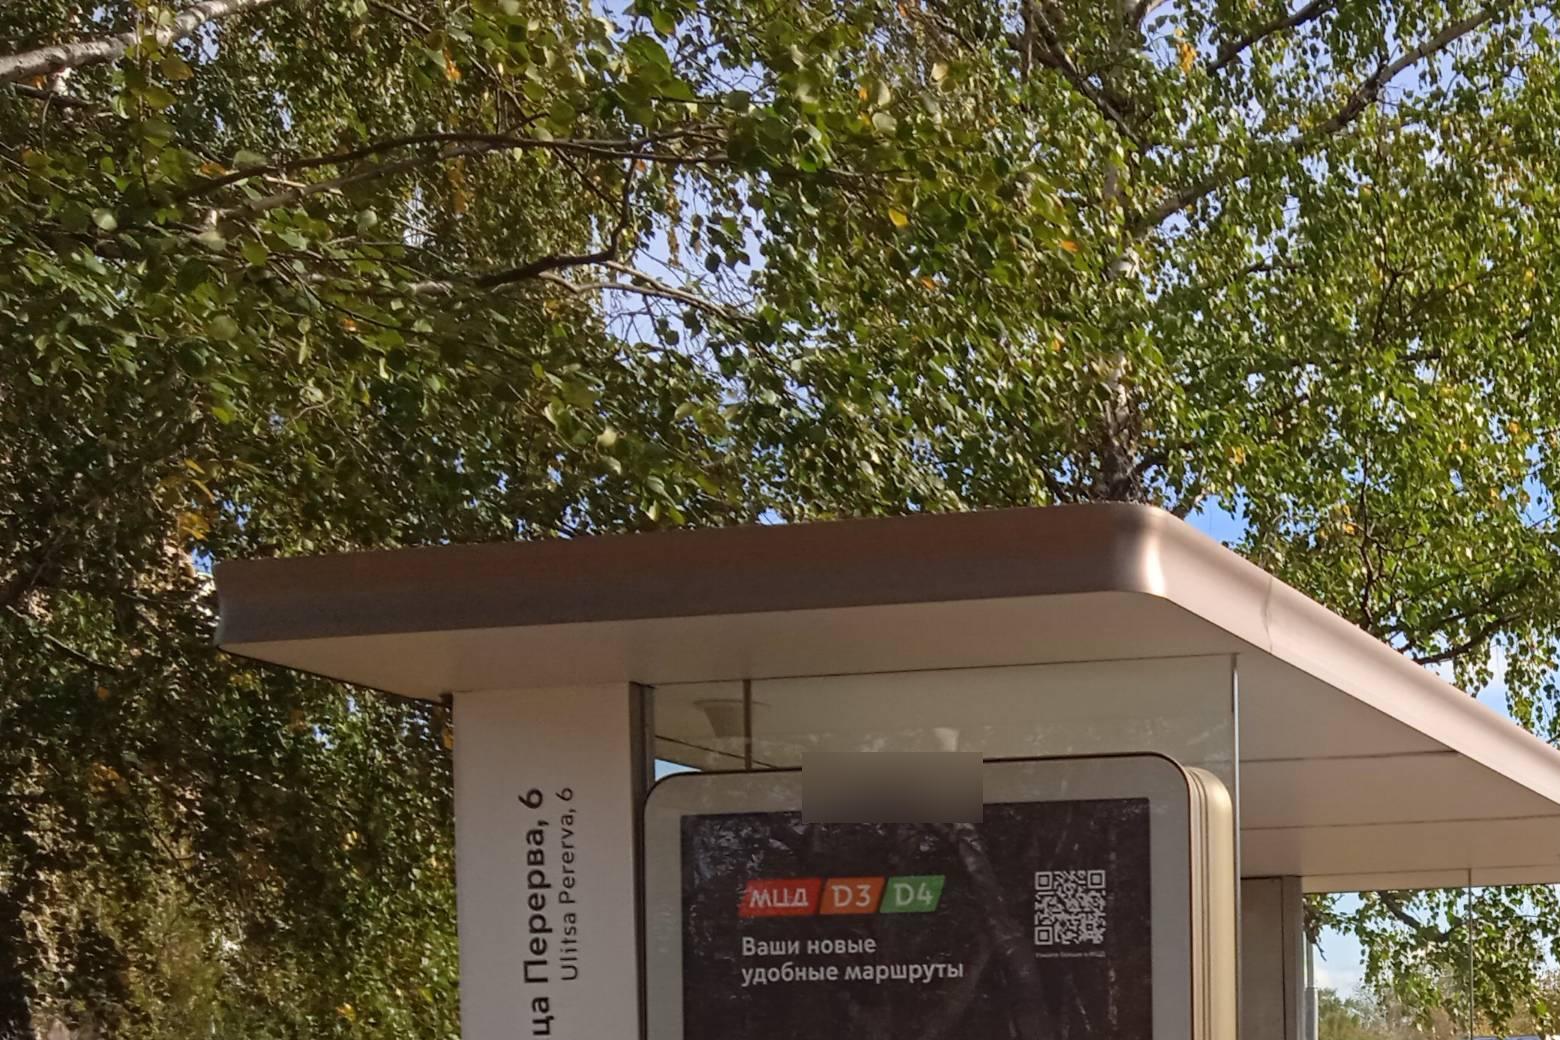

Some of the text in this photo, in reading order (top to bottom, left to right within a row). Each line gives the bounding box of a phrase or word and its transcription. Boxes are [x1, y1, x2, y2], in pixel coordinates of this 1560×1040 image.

[517, 786, 544, 810] 6
[554, 786, 579, 981] Ulitsa Pererva, 6
[748, 882, 934, 908] МЦД D3 D4
[523, 818, 553, 985] Перерва,
[741, 936, 877, 956] Ваши новые
[741, 961, 964, 988] удобные маршруты
